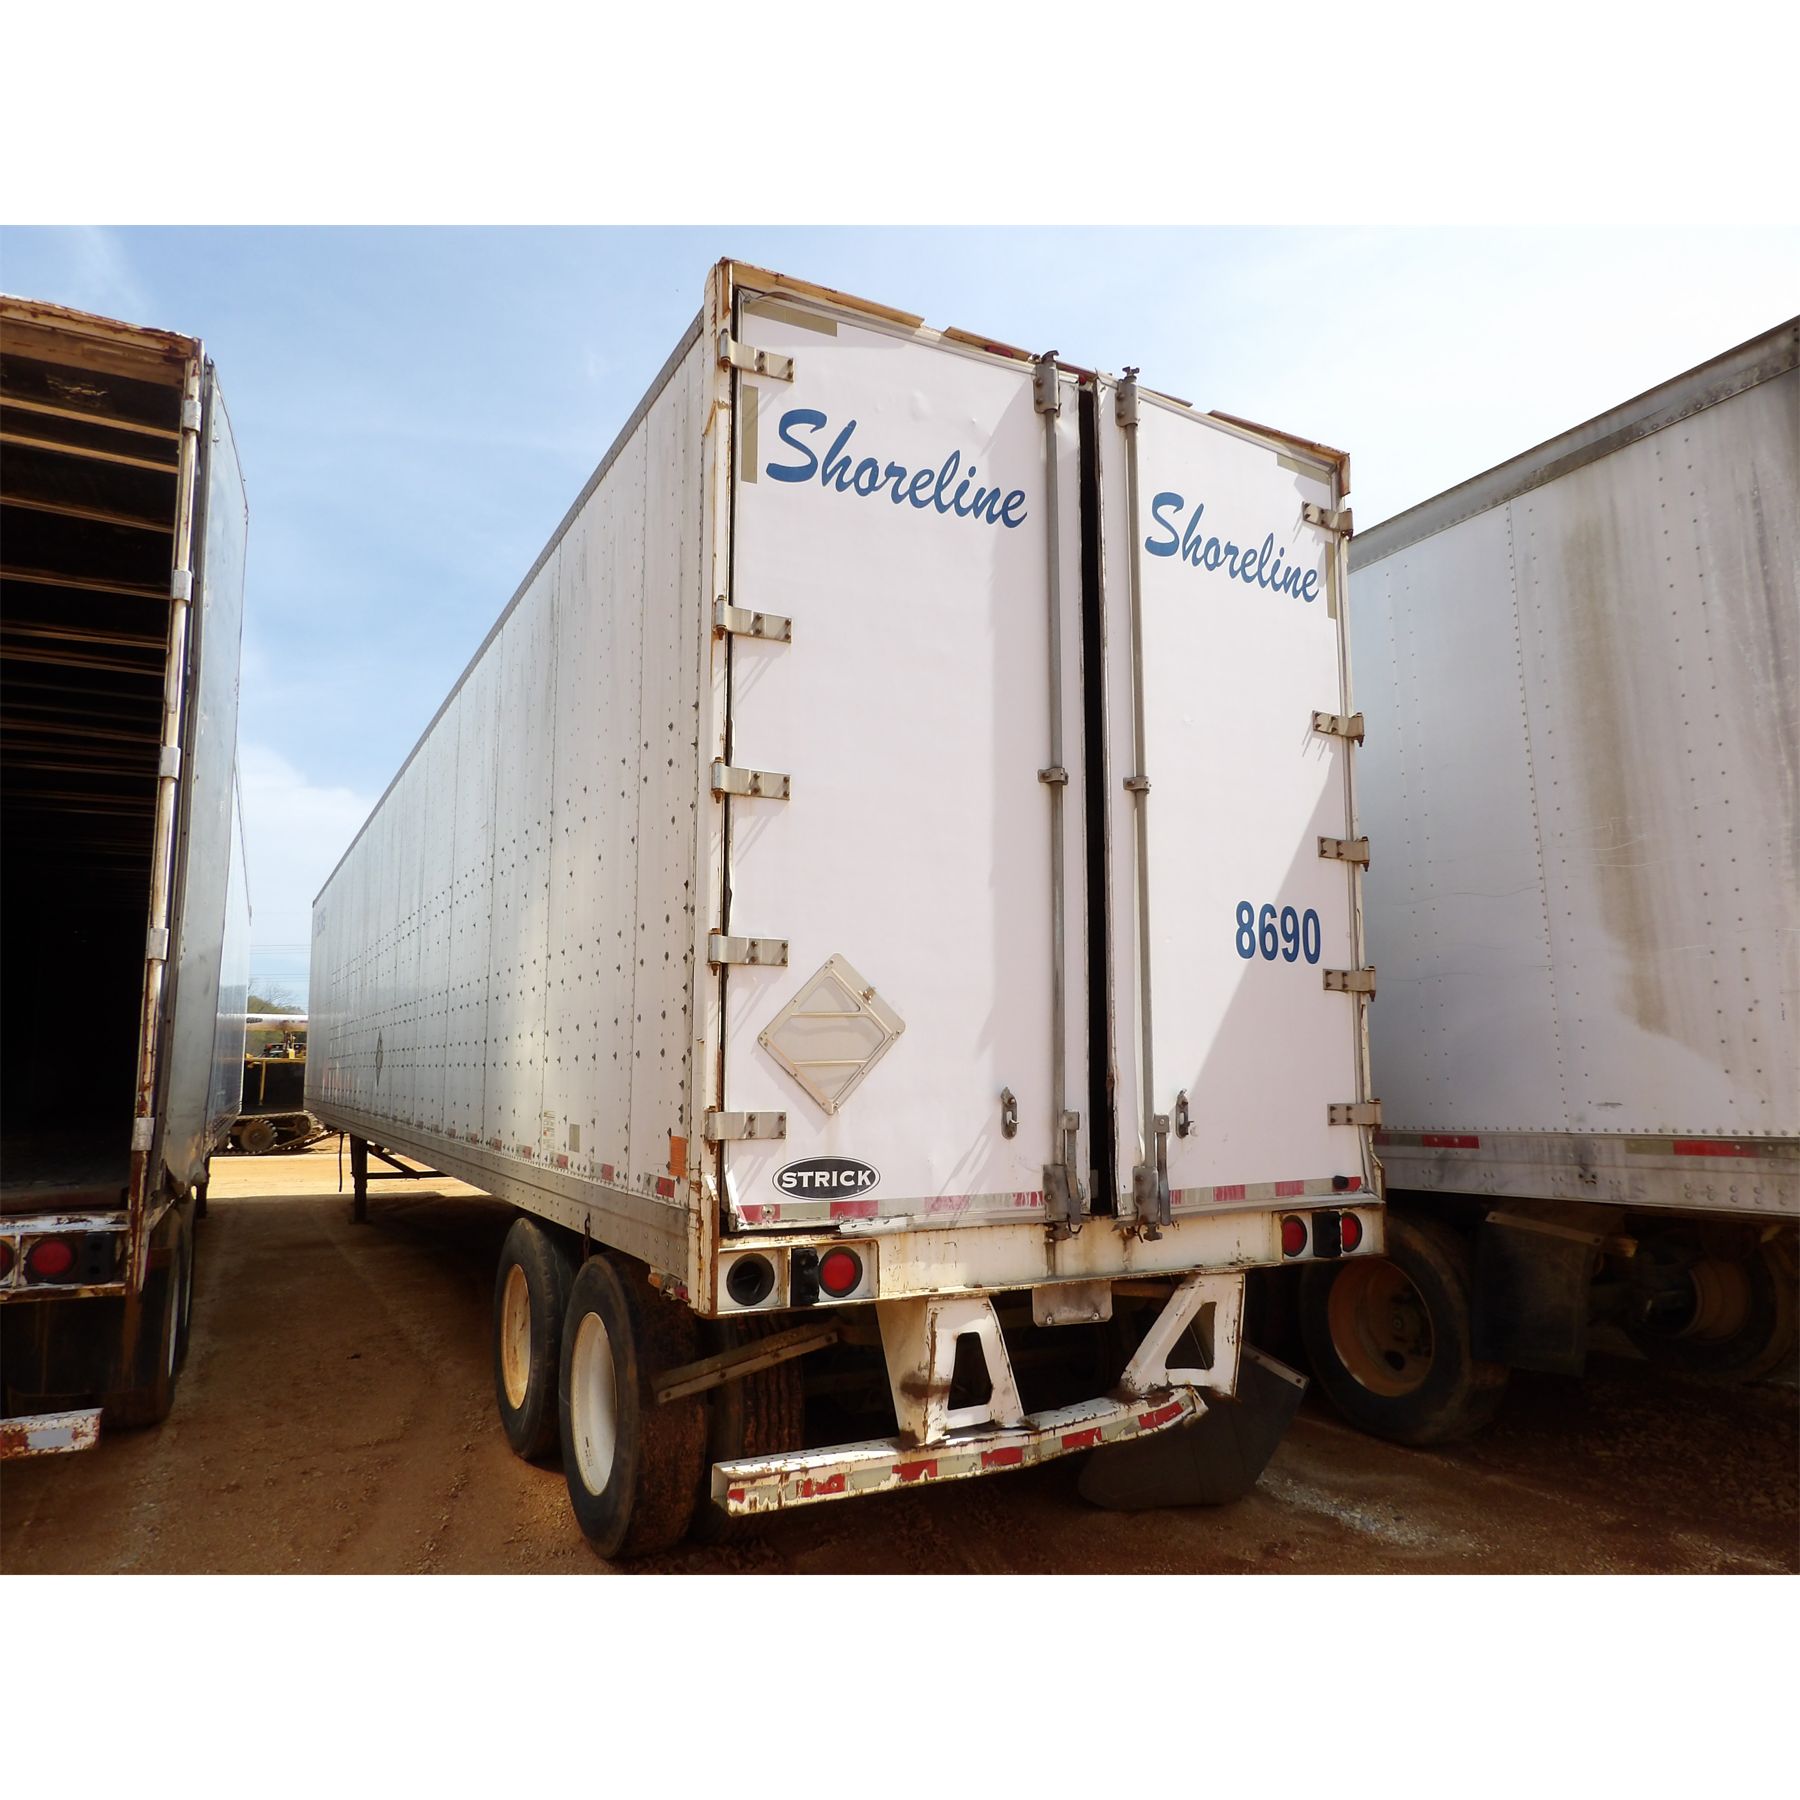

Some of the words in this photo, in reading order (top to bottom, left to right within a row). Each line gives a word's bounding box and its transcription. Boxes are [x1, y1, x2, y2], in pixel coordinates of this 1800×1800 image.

[767, 408, 1028, 529] Shoreline
[1145, 491, 1320, 603] Shoreline
[1236, 901, 1322, 964] 8690
[779, 1169, 874, 1190] STRICK
